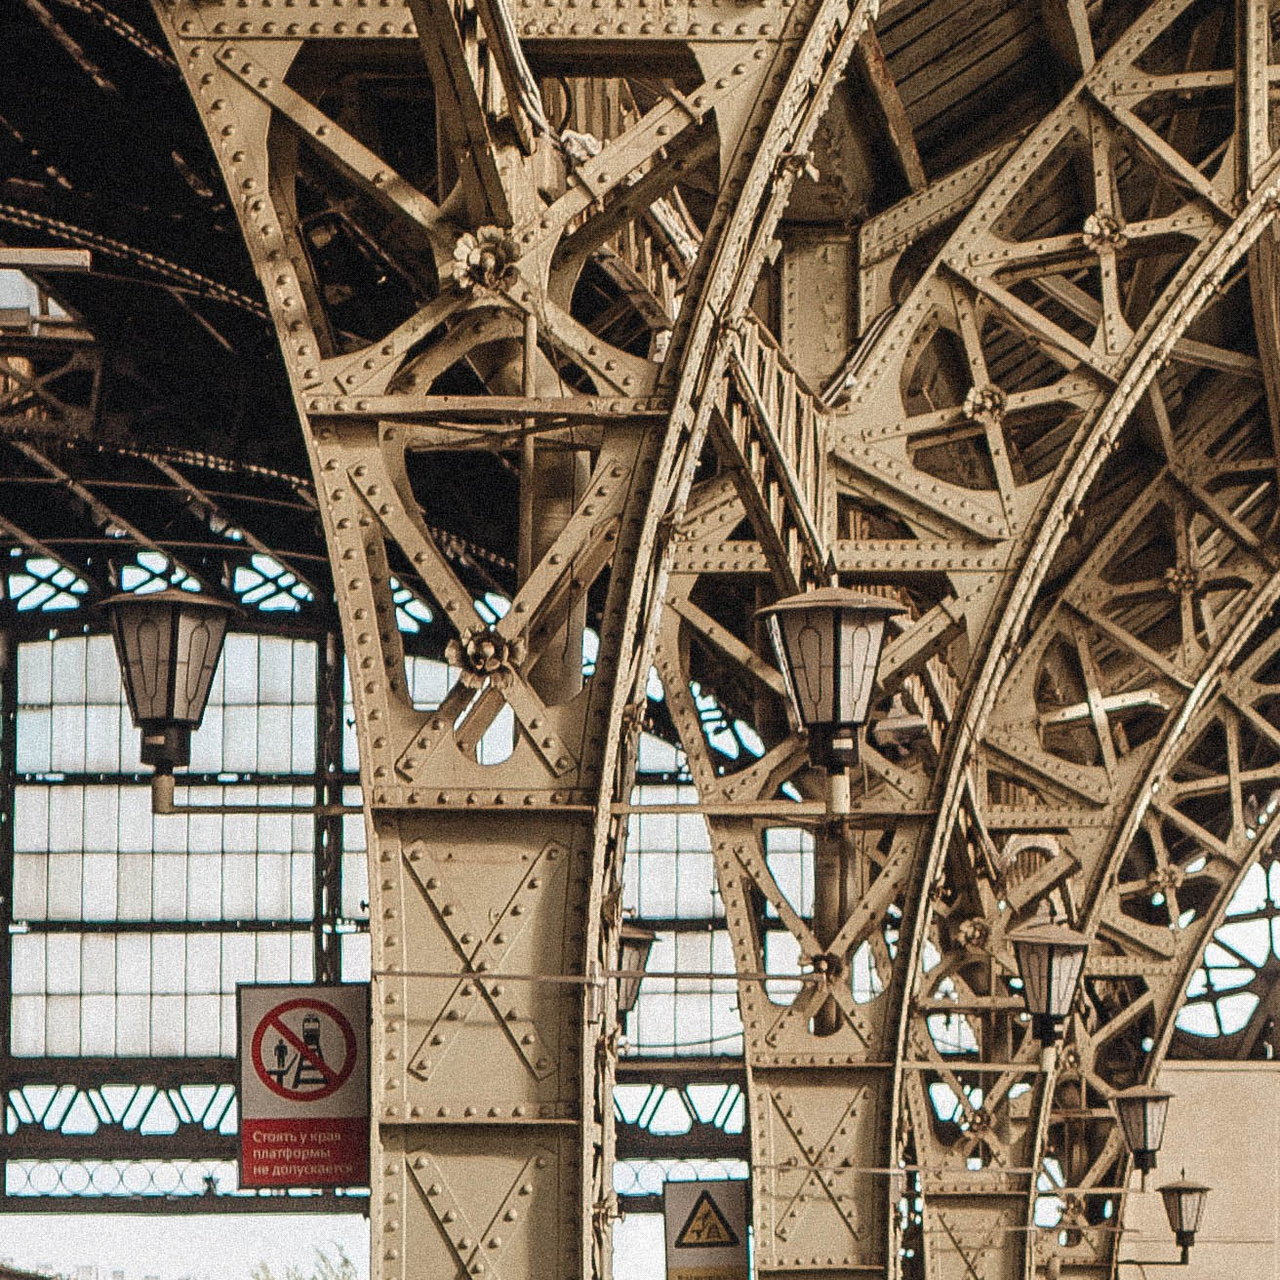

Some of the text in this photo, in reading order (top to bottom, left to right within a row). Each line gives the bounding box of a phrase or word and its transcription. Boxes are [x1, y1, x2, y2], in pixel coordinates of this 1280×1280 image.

[252, 1130, 341, 1144] Стоять у края
[253, 1147, 331, 1161] платформы
[253, 1164, 354, 1177] не допускается
